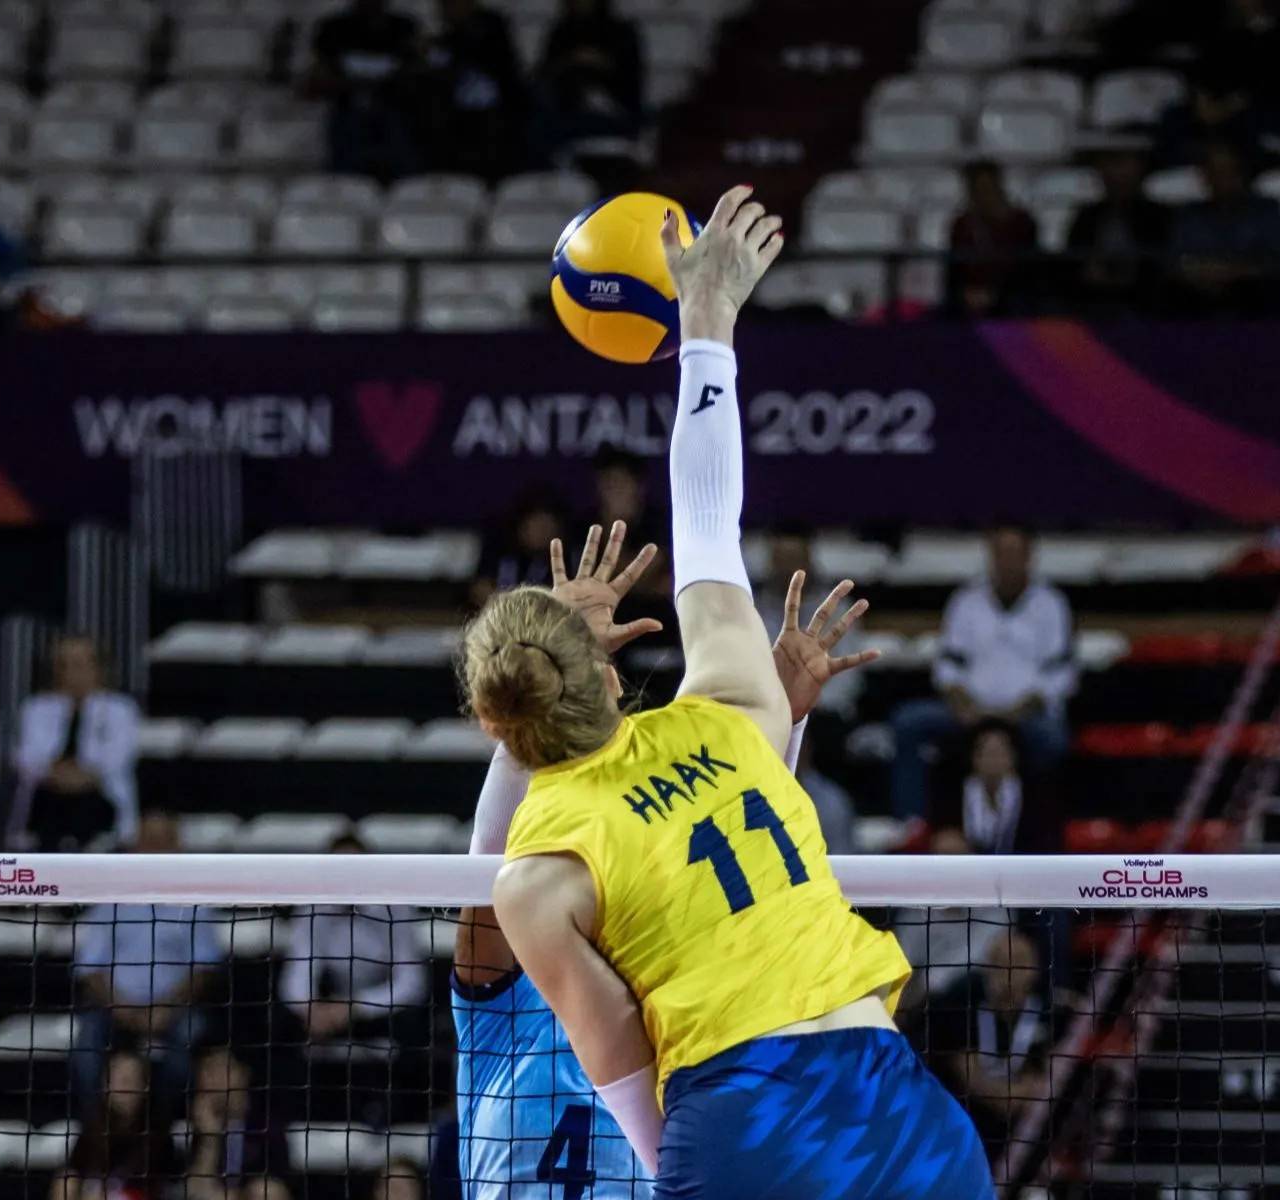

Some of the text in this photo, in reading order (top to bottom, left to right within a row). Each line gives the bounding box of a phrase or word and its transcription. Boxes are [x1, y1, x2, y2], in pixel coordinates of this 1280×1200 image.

[589, 279, 620, 294] FIVB
[71, 390, 937, 459] WOMEN ANTAL 2022
[621, 743, 737, 825] HAAK
[687, 787, 811, 914] 11
[1123, 858, 1164, 868] Volleyball
[1102, 869, 1183, 885] CLUB
[1078, 886, 1209, 898] WORLD CHAMPS
